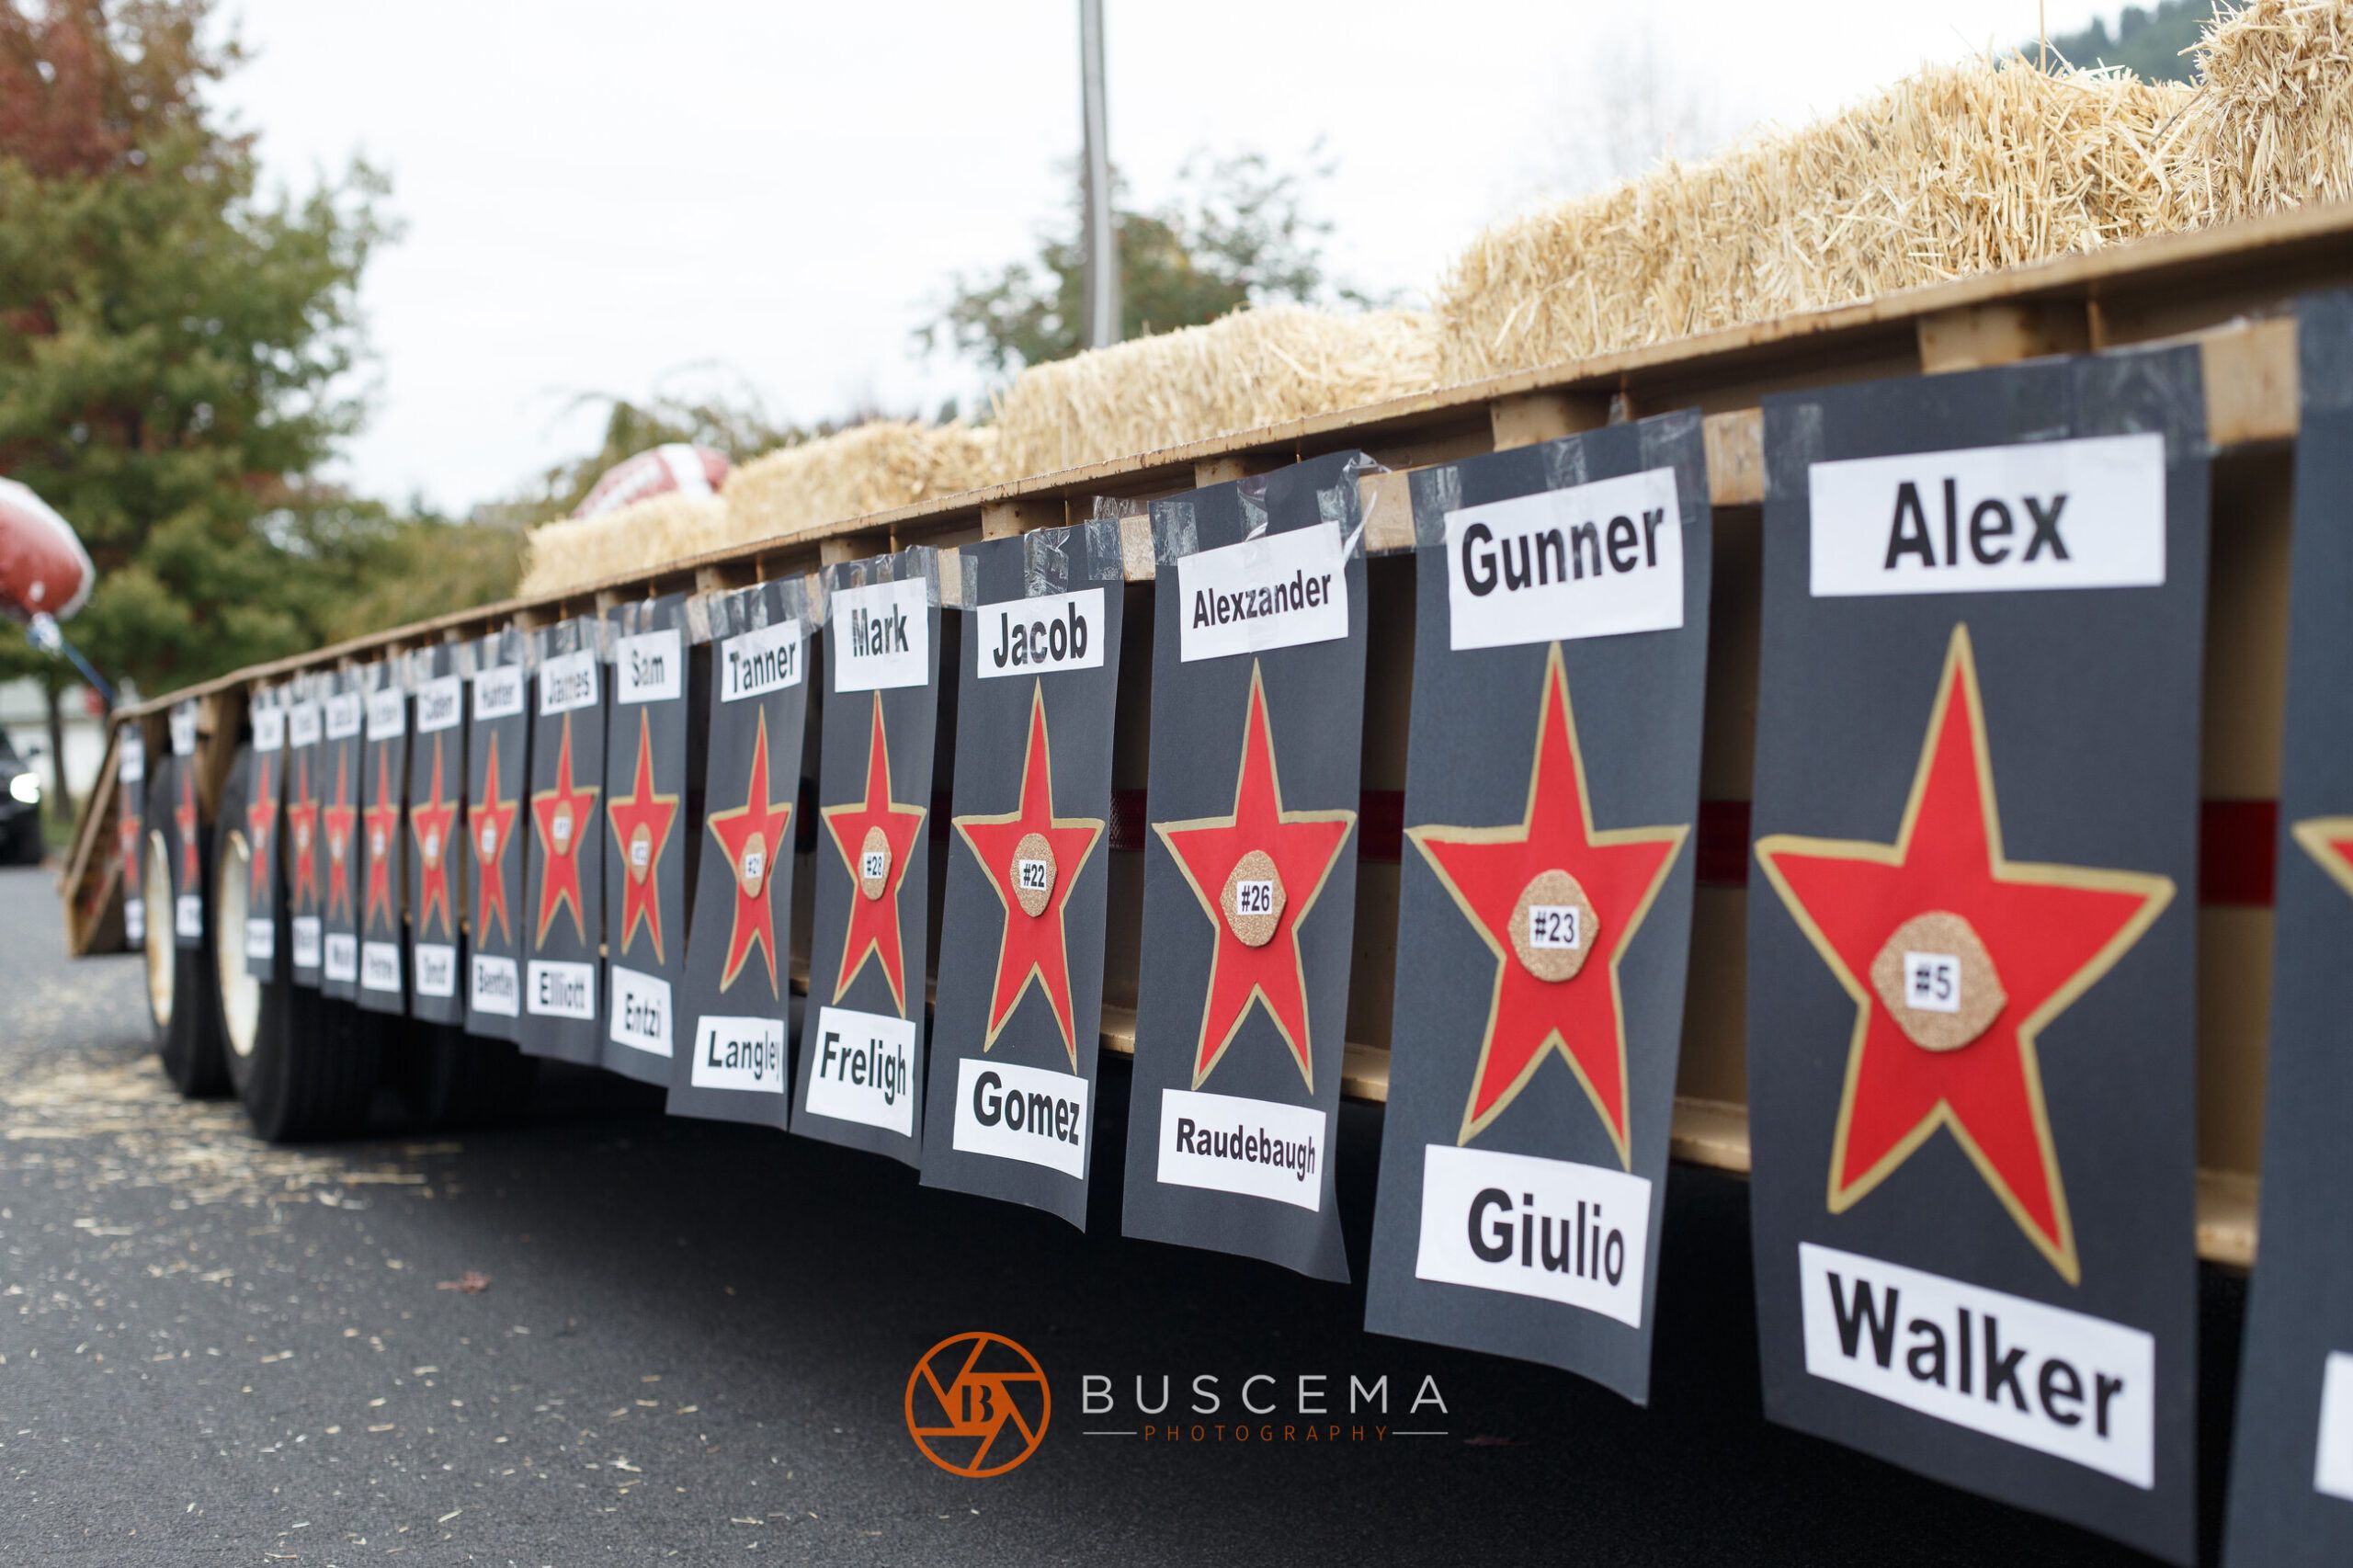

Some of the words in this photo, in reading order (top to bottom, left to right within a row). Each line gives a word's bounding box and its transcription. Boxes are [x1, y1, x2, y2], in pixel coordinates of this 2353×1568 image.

[1884, 477, 2071, 570] Alex
[1461, 506, 1665, 597] Gunner
[1192, 569, 1332, 631] Alexzander
[851, 603, 910, 658] Mark
[993, 601, 1088, 668] Jacob
[549, 669, 590, 707] James
[631, 649, 665, 687] Sam
[729, 641, 798, 694] Tanner
[867, 856, 883, 876] #28
[1023, 863, 1046, 888] #22
[1241, 884, 1270, 912] #26
[1534, 913, 1575, 943] #23
[540, 970, 585, 1009] Elliott
[1915, 964, 1952, 1000] #5
[625, 993, 662, 1039] Entzi
[820, 1031, 907, 1106] Freligh
[972, 1070, 1081, 1146] Gomez
[1176, 1117, 1316, 1182] Raudebaugh
[1468, 1187, 1625, 1288] Giulio
[1826, 1270, 2124, 1440] Walker
